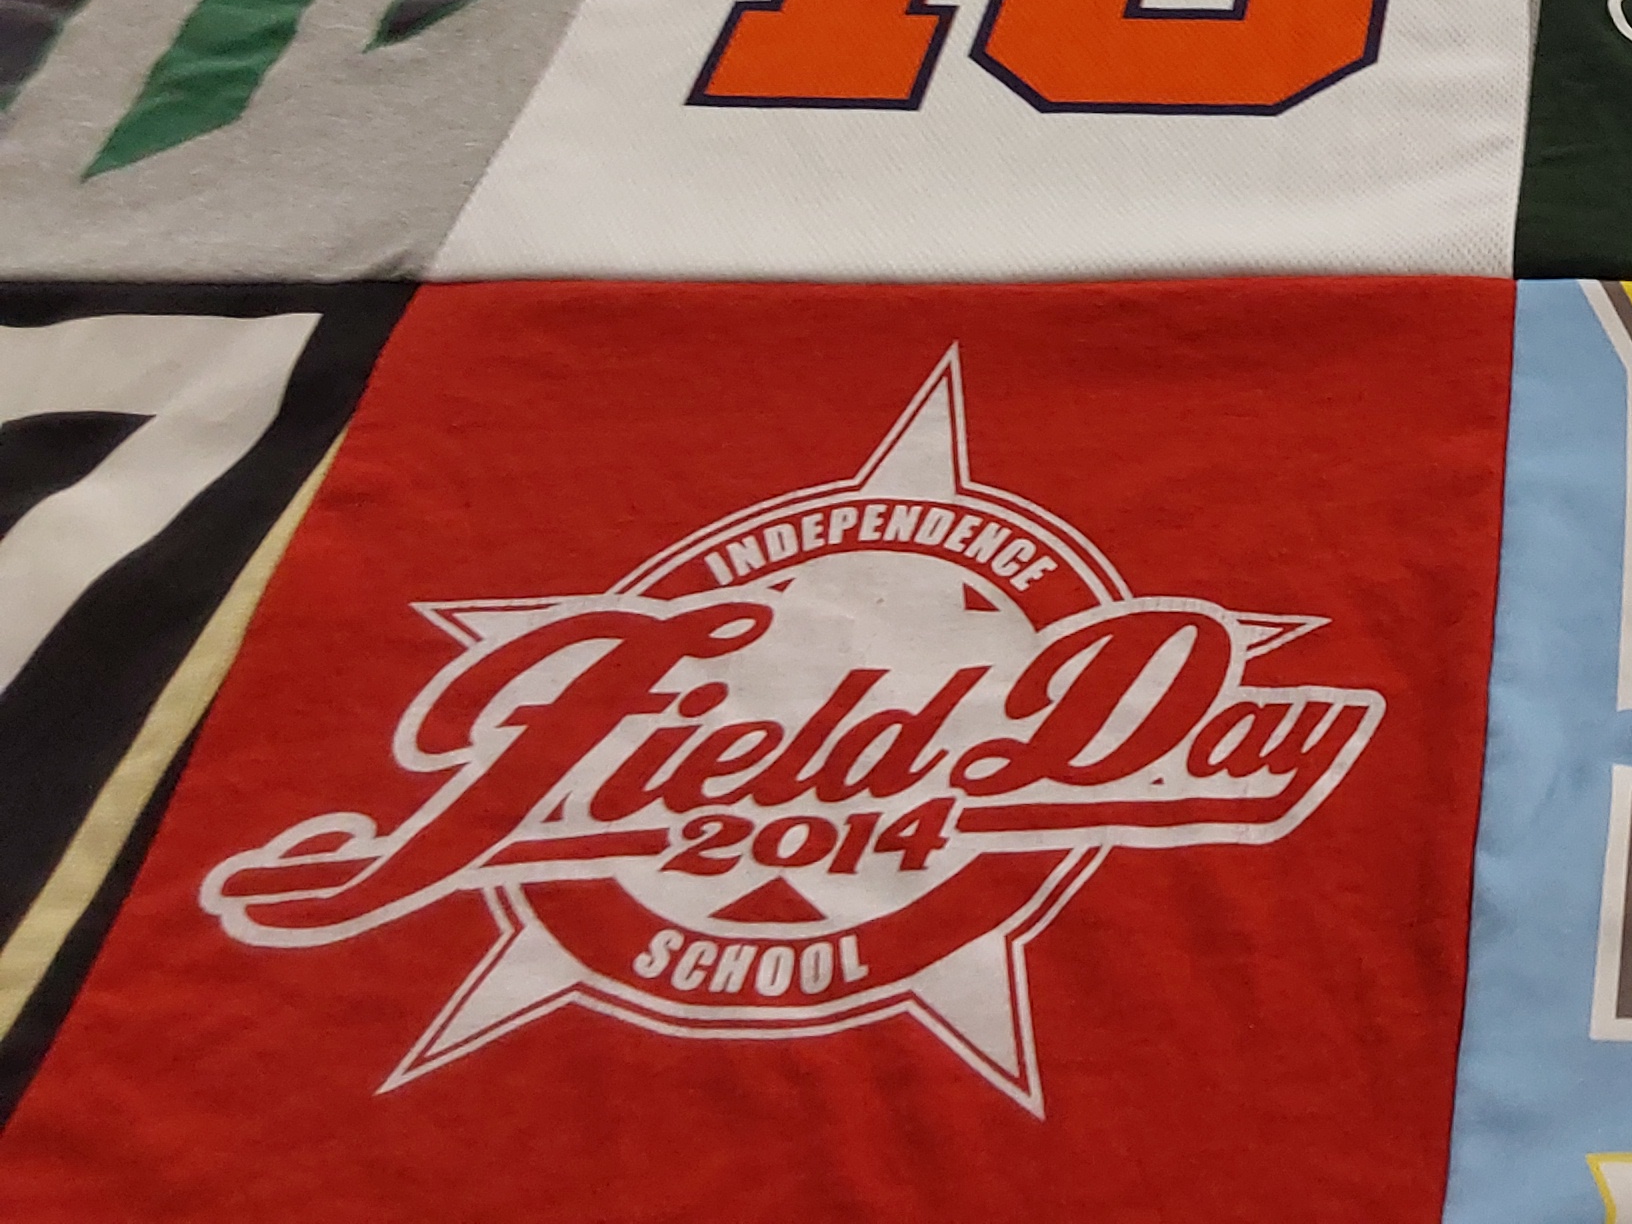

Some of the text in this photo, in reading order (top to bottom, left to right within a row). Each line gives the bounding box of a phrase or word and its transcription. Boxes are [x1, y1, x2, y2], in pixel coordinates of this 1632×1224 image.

[703, 503, 1060, 592] INDEPENDENCE
[201, 595, 1388, 948] Field Day
[660, 798, 965, 878] 2014
[633, 928, 870, 999] SCHOOL
